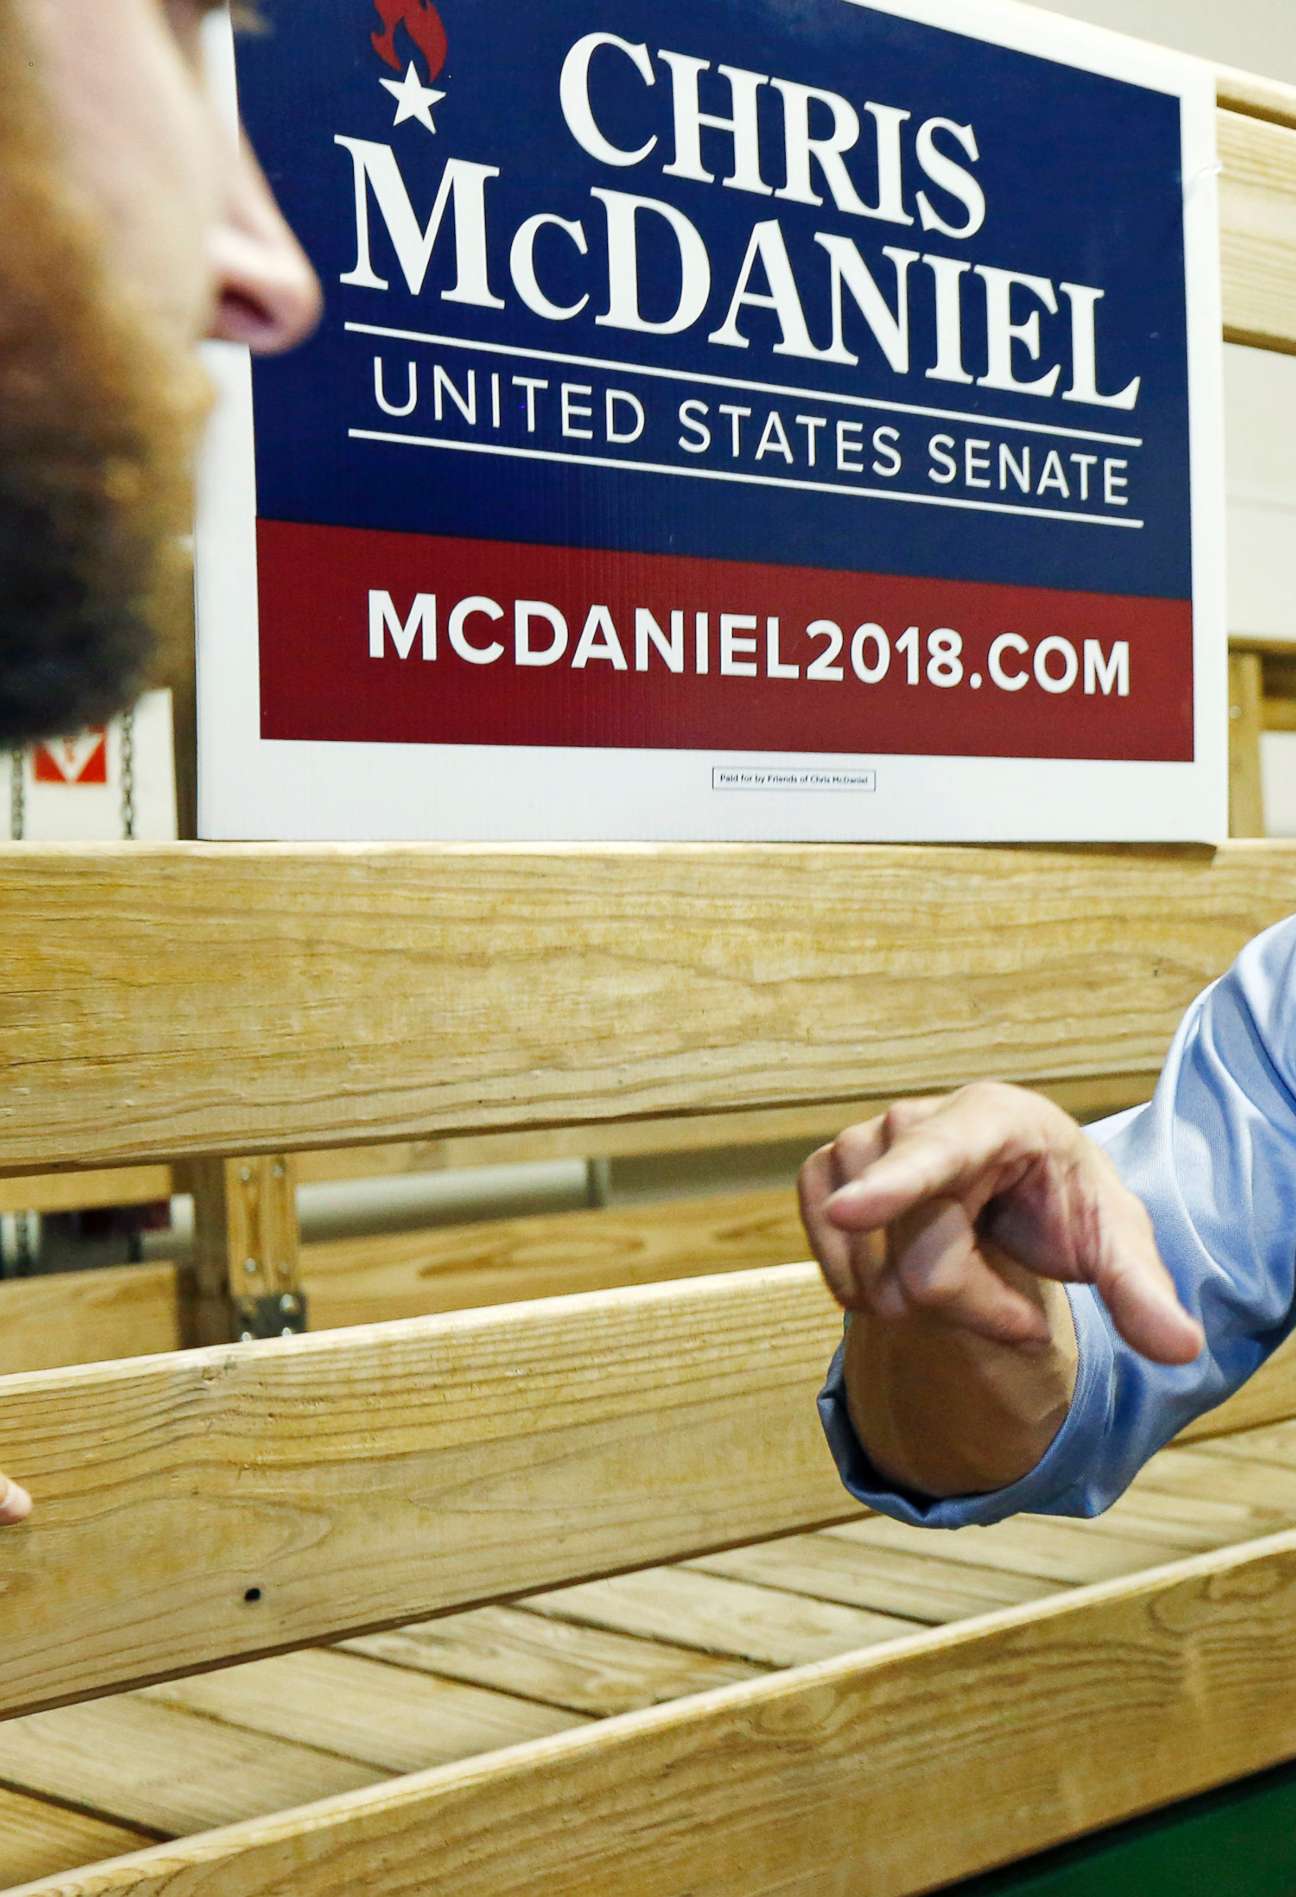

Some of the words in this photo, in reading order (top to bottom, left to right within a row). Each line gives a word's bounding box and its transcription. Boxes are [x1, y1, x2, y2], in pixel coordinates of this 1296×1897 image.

[559, 32, 986, 240] CHRIS
[333, 134, 1143, 411] McDANIEL
[373, 356, 645, 444] UNITED
[678, 399, 902, 477] STATES
[928, 433, 1130, 506] SENATE
[368, 589, 1131, 698] MCDANIEL2018.COM
[719, 774, 739, 783] Paid
[741, 774, 753, 783] for
[755, 775, 766, 785] by
